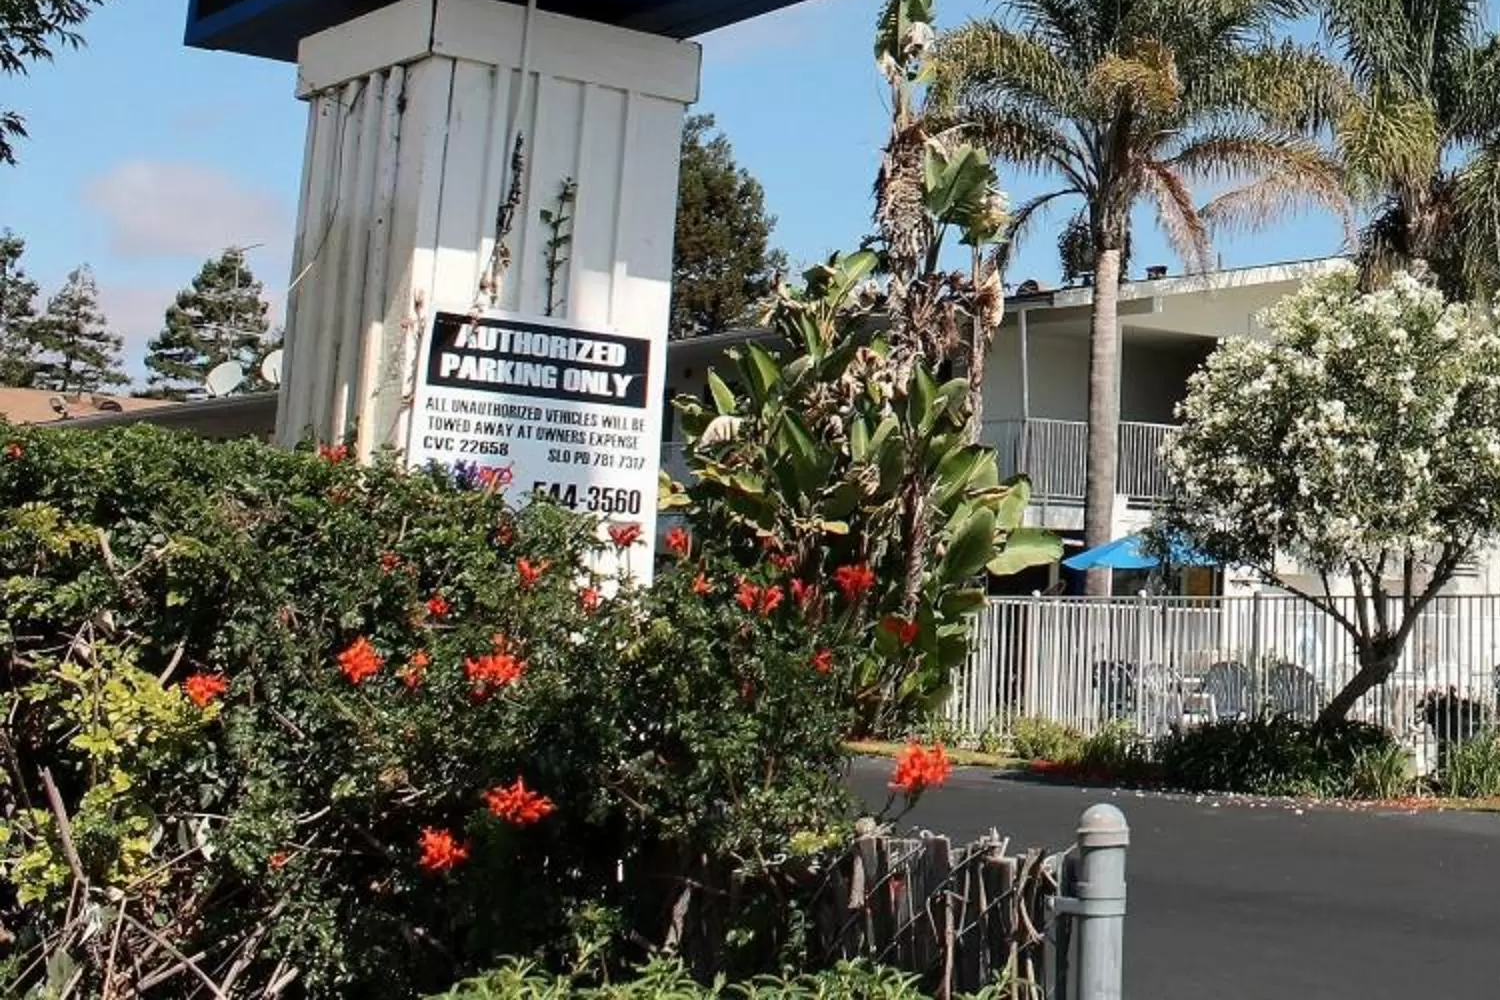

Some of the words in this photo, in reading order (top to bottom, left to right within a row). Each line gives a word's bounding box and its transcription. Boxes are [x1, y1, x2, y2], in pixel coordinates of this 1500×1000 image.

[453, 323, 627, 367] AUTHORIZED
[439, 352, 557, 389] PARKING
[562, 367, 634, 398] ONLY
[426, 396, 448, 413] ALL
[451, 399, 542, 420] UNAUTHORIZED
[545, 407, 598, 427] VEHICLES
[602, 414, 628, 430] WILL
[631, 417, 646, 432] BE
[423, 435, 455, 451] CVC
[459, 439, 509, 456] 22658
[428, 415, 471, 433] TOWED
[474, 421, 514, 437] AWAY
[517, 424, 533, 439] AT
[536, 427, 587, 445] OWNERS
[589, 431, 641, 450] EXPENSE
[547, 447, 571, 463] SLO
[573, 451, 591, 465] PD
[593, 452, 614, 467] 781
[618, 455, 646, 470] 7317
